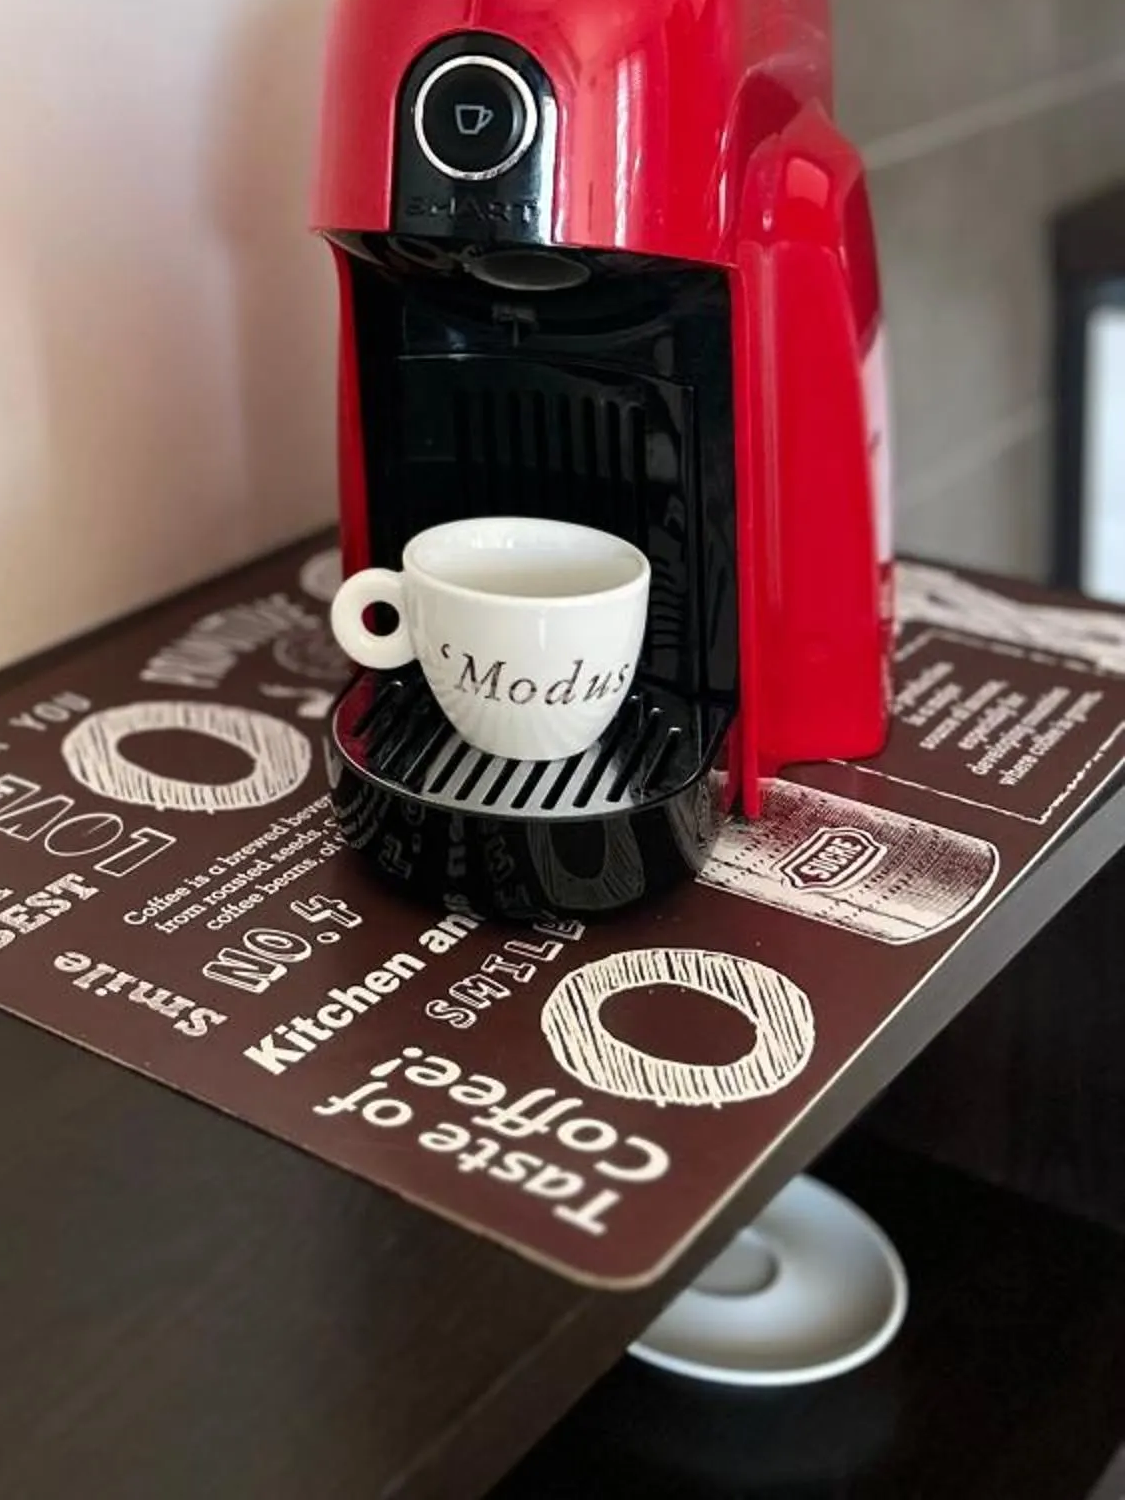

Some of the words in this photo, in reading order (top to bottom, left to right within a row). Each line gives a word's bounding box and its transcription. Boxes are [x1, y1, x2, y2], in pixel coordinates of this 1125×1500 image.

[8, 691, 91, 733] YOU
[217, 821, 289, 867] brewed
[184, 874, 211, 889] is
[208, 864, 228, 876] a
[123, 886, 191, 925] Coffee
[154, 902, 207, 934] from
[203, 858, 274, 905] roasted
[206, 892, 265, 931] coffee
[425, 911, 586, 1029] SMILE
[242, 950, 427, 1076] Kitchen
[418, 913, 480, 955] an
[312, 1080, 414, 1128] of
[370, 1046, 671, 1183] Coffee!
[418, 1121, 623, 1237] Taste
